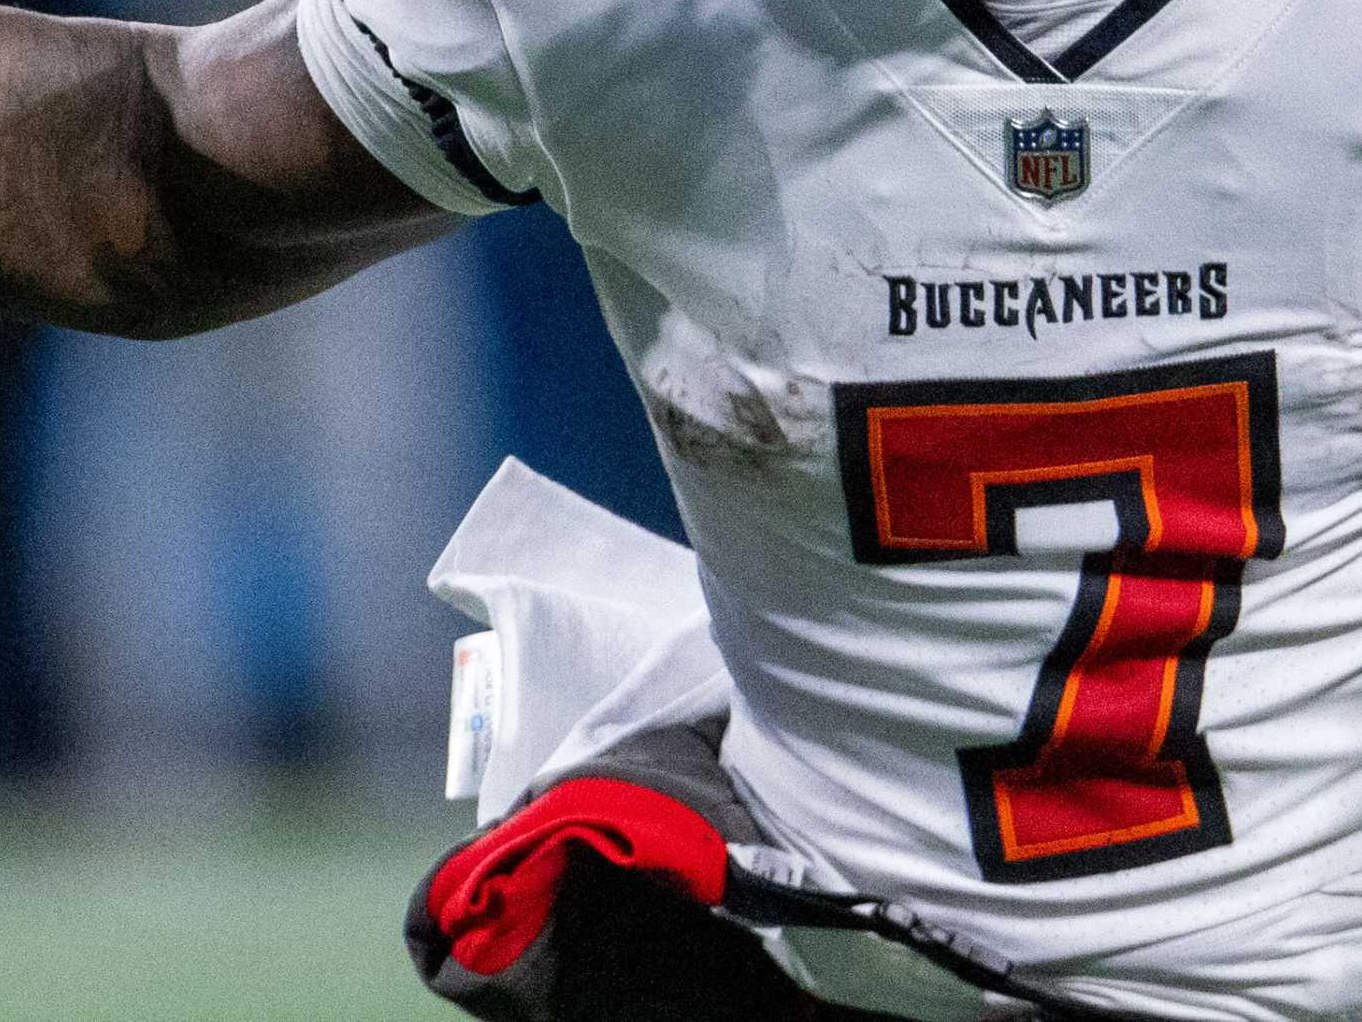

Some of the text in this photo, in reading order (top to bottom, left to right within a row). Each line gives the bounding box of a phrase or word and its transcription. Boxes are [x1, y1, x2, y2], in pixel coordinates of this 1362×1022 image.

[1020, 154, 1079, 191] NFL
[881, 262, 1227, 340] BUCCANEERS
[831, 348, 1286, 885] 7
